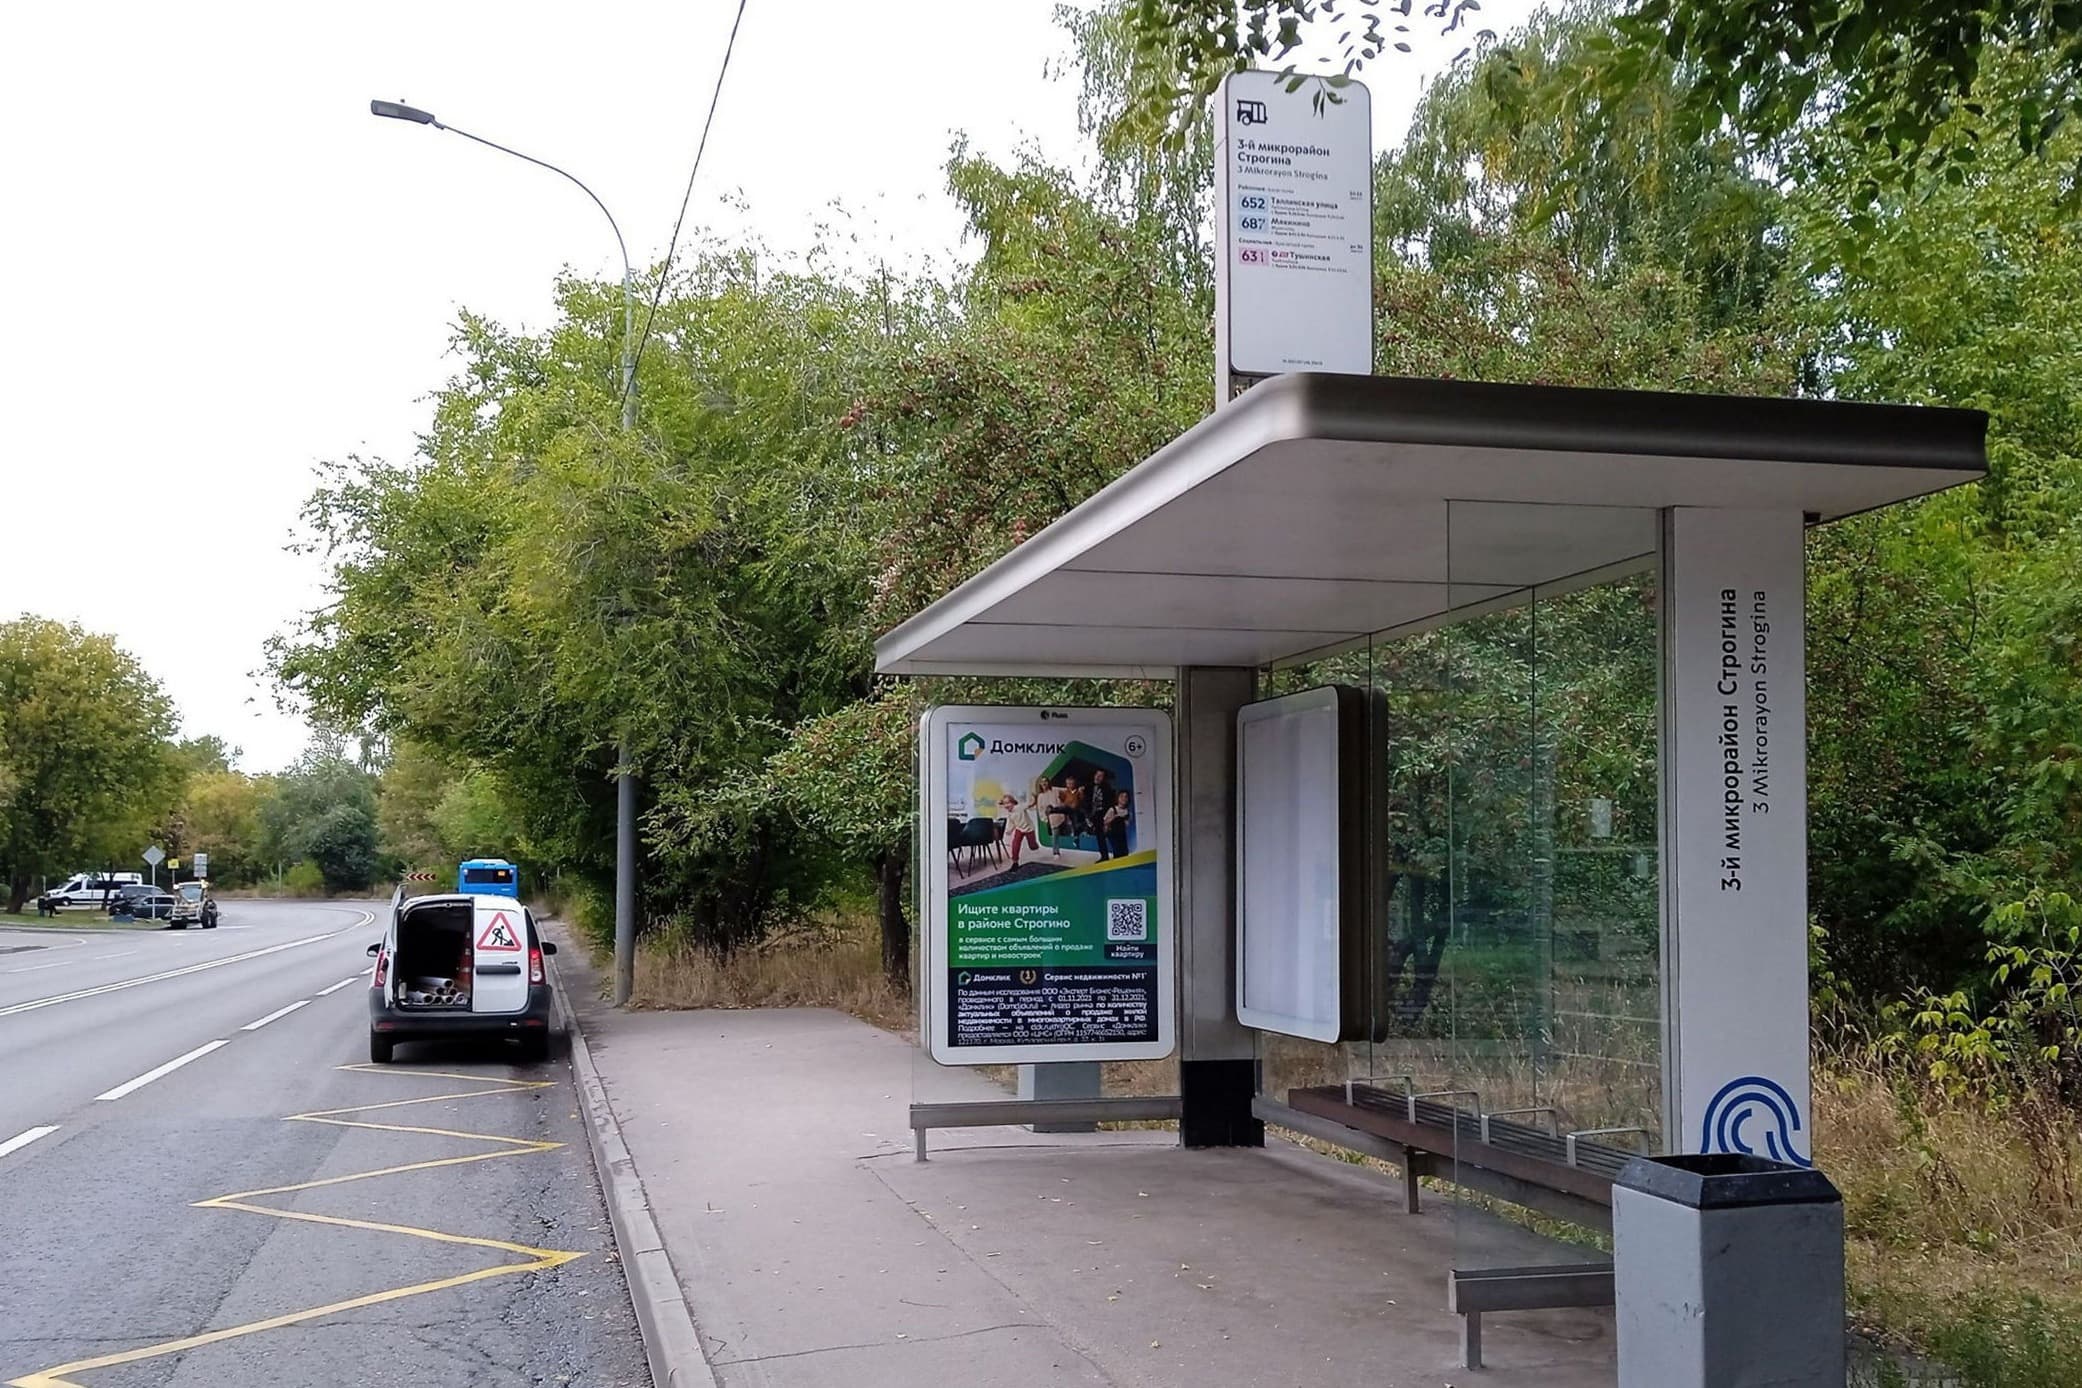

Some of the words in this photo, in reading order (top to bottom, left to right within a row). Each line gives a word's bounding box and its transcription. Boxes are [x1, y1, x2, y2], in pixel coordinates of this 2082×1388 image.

[1237, 138, 1255, 150] 3-й
[1258, 141, 1330, 157] микрорайон
[1237, 151, 1292, 165] Строгина
[1238, 165, 1243, 174] 3
[1244, 166, 1292, 177] Mikrorayon
[1294, 169, 1328, 180] Strogina
[1241, 196, 1265, 209] 652
[1241, 217, 1265, 230] 687
[1241, 250, 1264, 263] 631
[1751, 590, 1770, 674] Strogina
[1718, 588, 1742, 696] Строгина
[1752, 681, 1771, 797] Mikrorayon
[990, 740, 1066, 754] Домклик
[1128, 742, 1143, 752] 6+
[1718, 704, 1743, 850] микрорайон
[1753, 802, 1769, 814] 3
[1720, 857, 1742, 891] 3-й
[958, 903, 998, 916] Ищите
[1001, 903, 1059, 917] квартиры
[958, 920, 965, 928] в
[968, 918, 1011, 931] районе
[1014, 918, 1071, 930] Строгино
[1110, 951, 1145, 959] квартиру
[973, 974, 1011, 982] Домклик
[1044, 973, 1073, 982] Сервис
